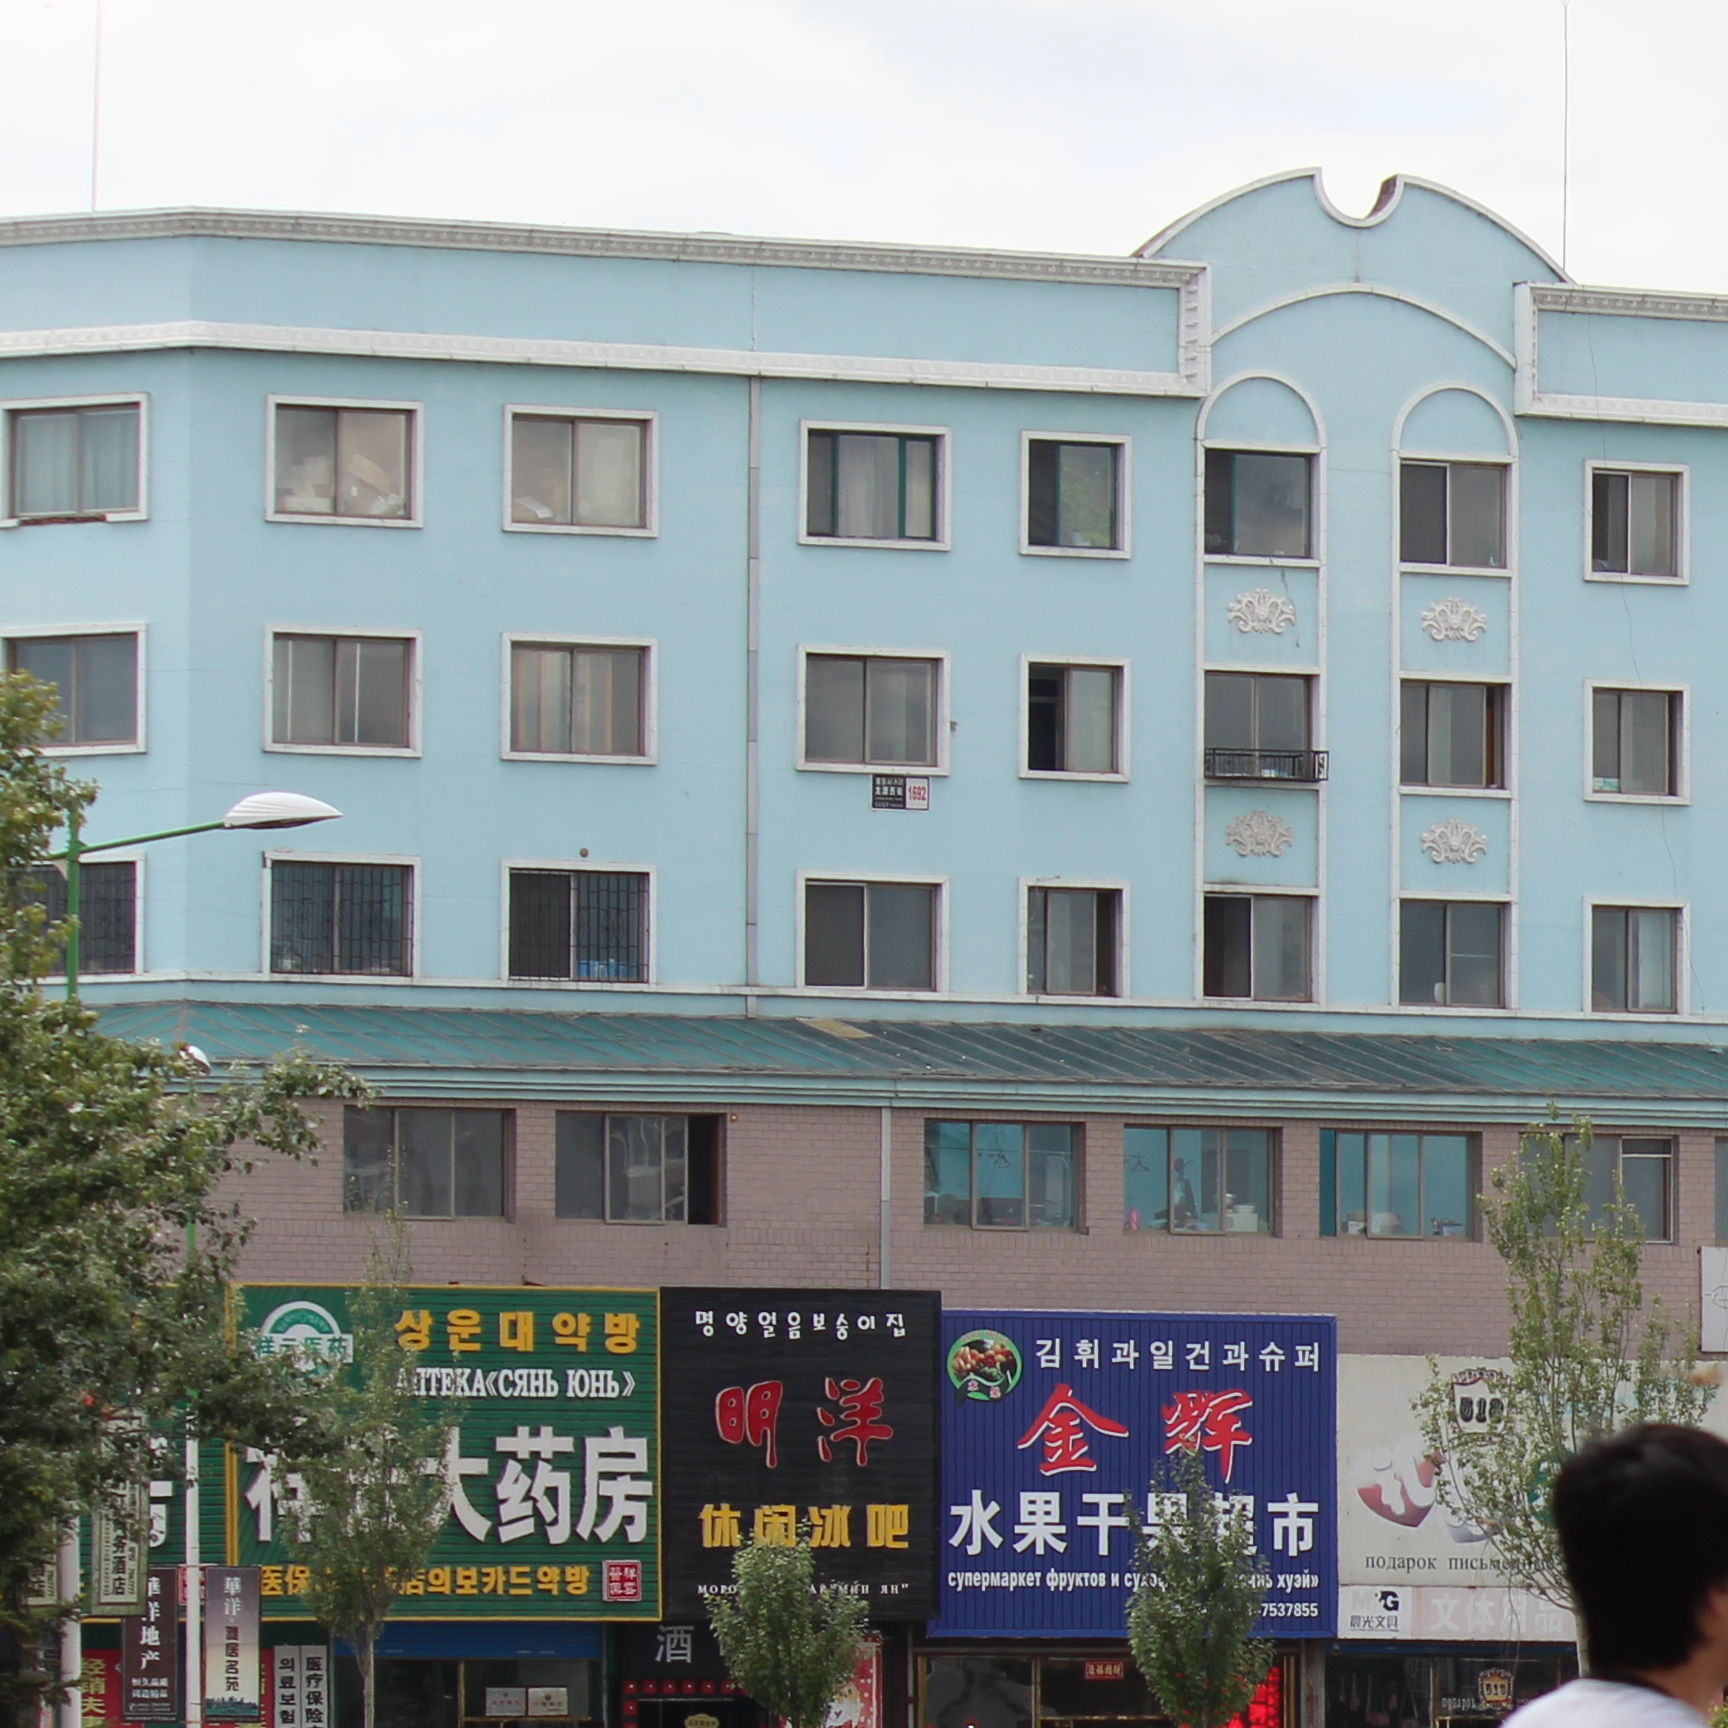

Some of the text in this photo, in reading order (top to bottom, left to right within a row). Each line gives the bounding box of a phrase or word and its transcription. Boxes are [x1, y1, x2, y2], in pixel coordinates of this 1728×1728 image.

[393, 1309, 640, 1354] 상운대약방
[1034, 1338, 1320, 1372] 김휘과일건과슈퍼
[715, 1378, 894, 1469] 明洋
[245, 1425, 654, 1545] 大药房
[698, 1502, 910, 1549] 休闲冰吧
[427, 1565, 591, 1597] 의보카드약방
[947, 1569, 1042, 1592] супермаркет
[1046, 1567, 1107, 1593] фруктов
[1111, 1573, 1120, 1588] и
[1364, 1554, 1437, 1574] подарок
[654, 1625, 694, 1664] 酒
